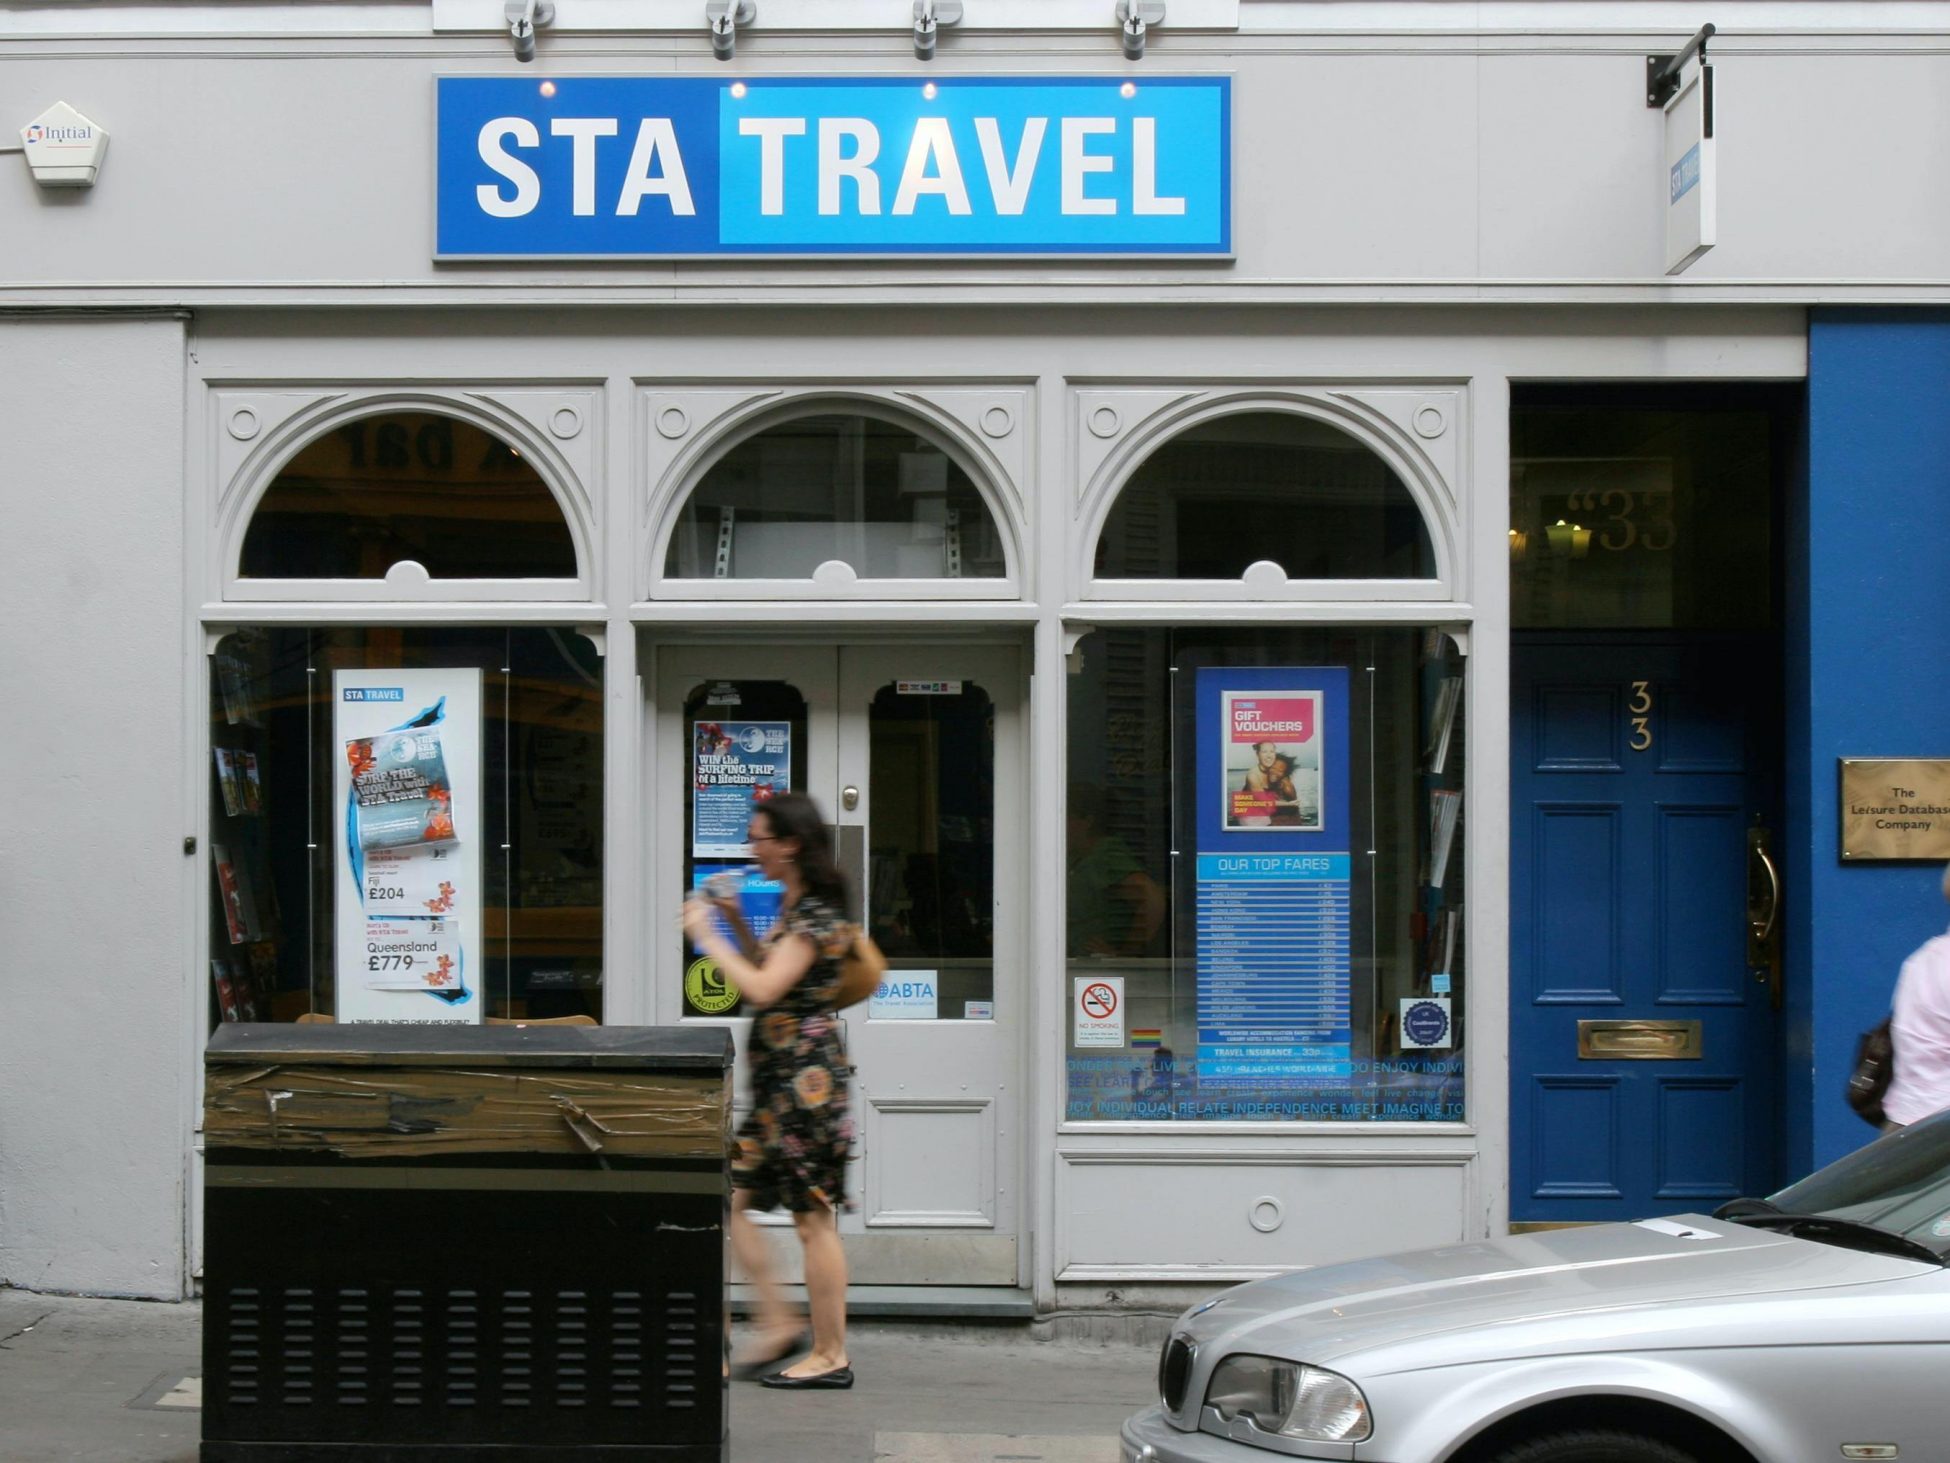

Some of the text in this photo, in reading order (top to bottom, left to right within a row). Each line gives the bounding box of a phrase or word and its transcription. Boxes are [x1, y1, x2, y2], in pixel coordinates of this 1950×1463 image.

[46, 126, 92, 139] Initial
[475, 116, 1185, 218] STA TRAVEL
[345, 690, 401, 700] STA TRAVEL
[1234, 710, 1262, 720] GIFT
[1234, 721, 1303, 732] VOUCHERS
[699, 754, 740, 764] WIN the
[698, 764, 775, 774] SURFING TRIP
[356, 767, 417, 786] SURF THE
[698, 774, 756, 784] of a lifetime
[358, 776, 430, 796] WORLD with
[361, 788, 424, 806] STA Travel
[1892, 788, 1915, 798] The
[1851, 805, 1895, 815] Leisure
[1875, 819, 1931, 831] Company
[1218, 858, 1330, 870] OUR TOP FARES
[368, 876, 380, 887] Fiji
[748, 880, 780, 888] HOURS
[368, 887, 405, 900] £204
[367, 941, 438, 953] Queensland
[367, 954, 414, 971] £779
[889, 983, 934, 998] ABTA
[693, 991, 735, 1009] PROTECTED
[1373, 1062, 1420, 1072] ENJOY
[1385, 1089, 1400, 1098] live
[1097, 1102, 1173, 1114] INDIVIDUAL
[1179, 1102, 1229, 1114] RELATE
[1233, 1102, 1336, 1114] INDEPENDENCE
[1342, 1102, 1380, 1114] MEET
[1383, 1102, 1442, 1114] IMAGINE
